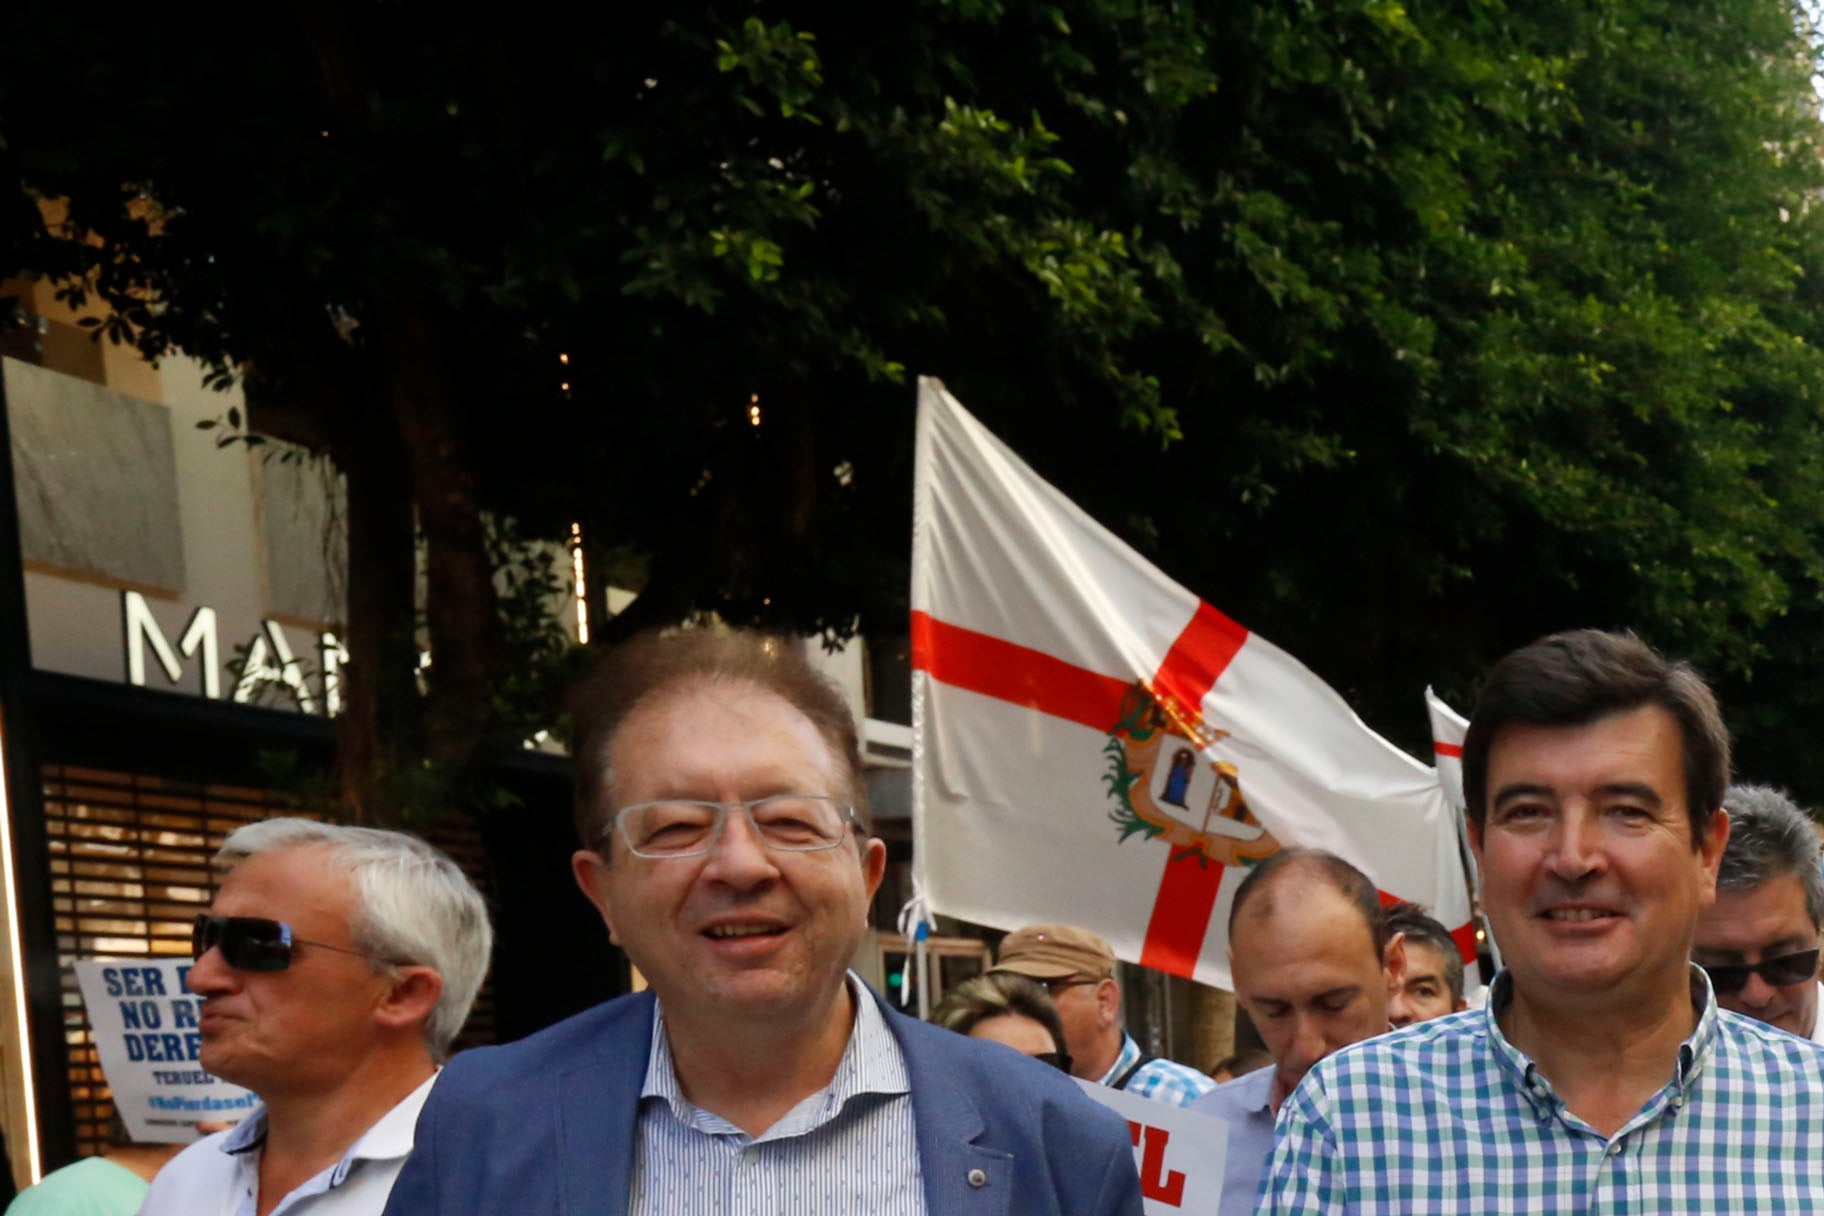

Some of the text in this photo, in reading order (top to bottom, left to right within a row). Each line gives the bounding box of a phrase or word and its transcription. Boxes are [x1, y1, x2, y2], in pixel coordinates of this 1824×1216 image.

[103, 968, 166, 997] SER
[120, 1001, 162, 1030] NO
[123, 1032, 202, 1062] DERE
